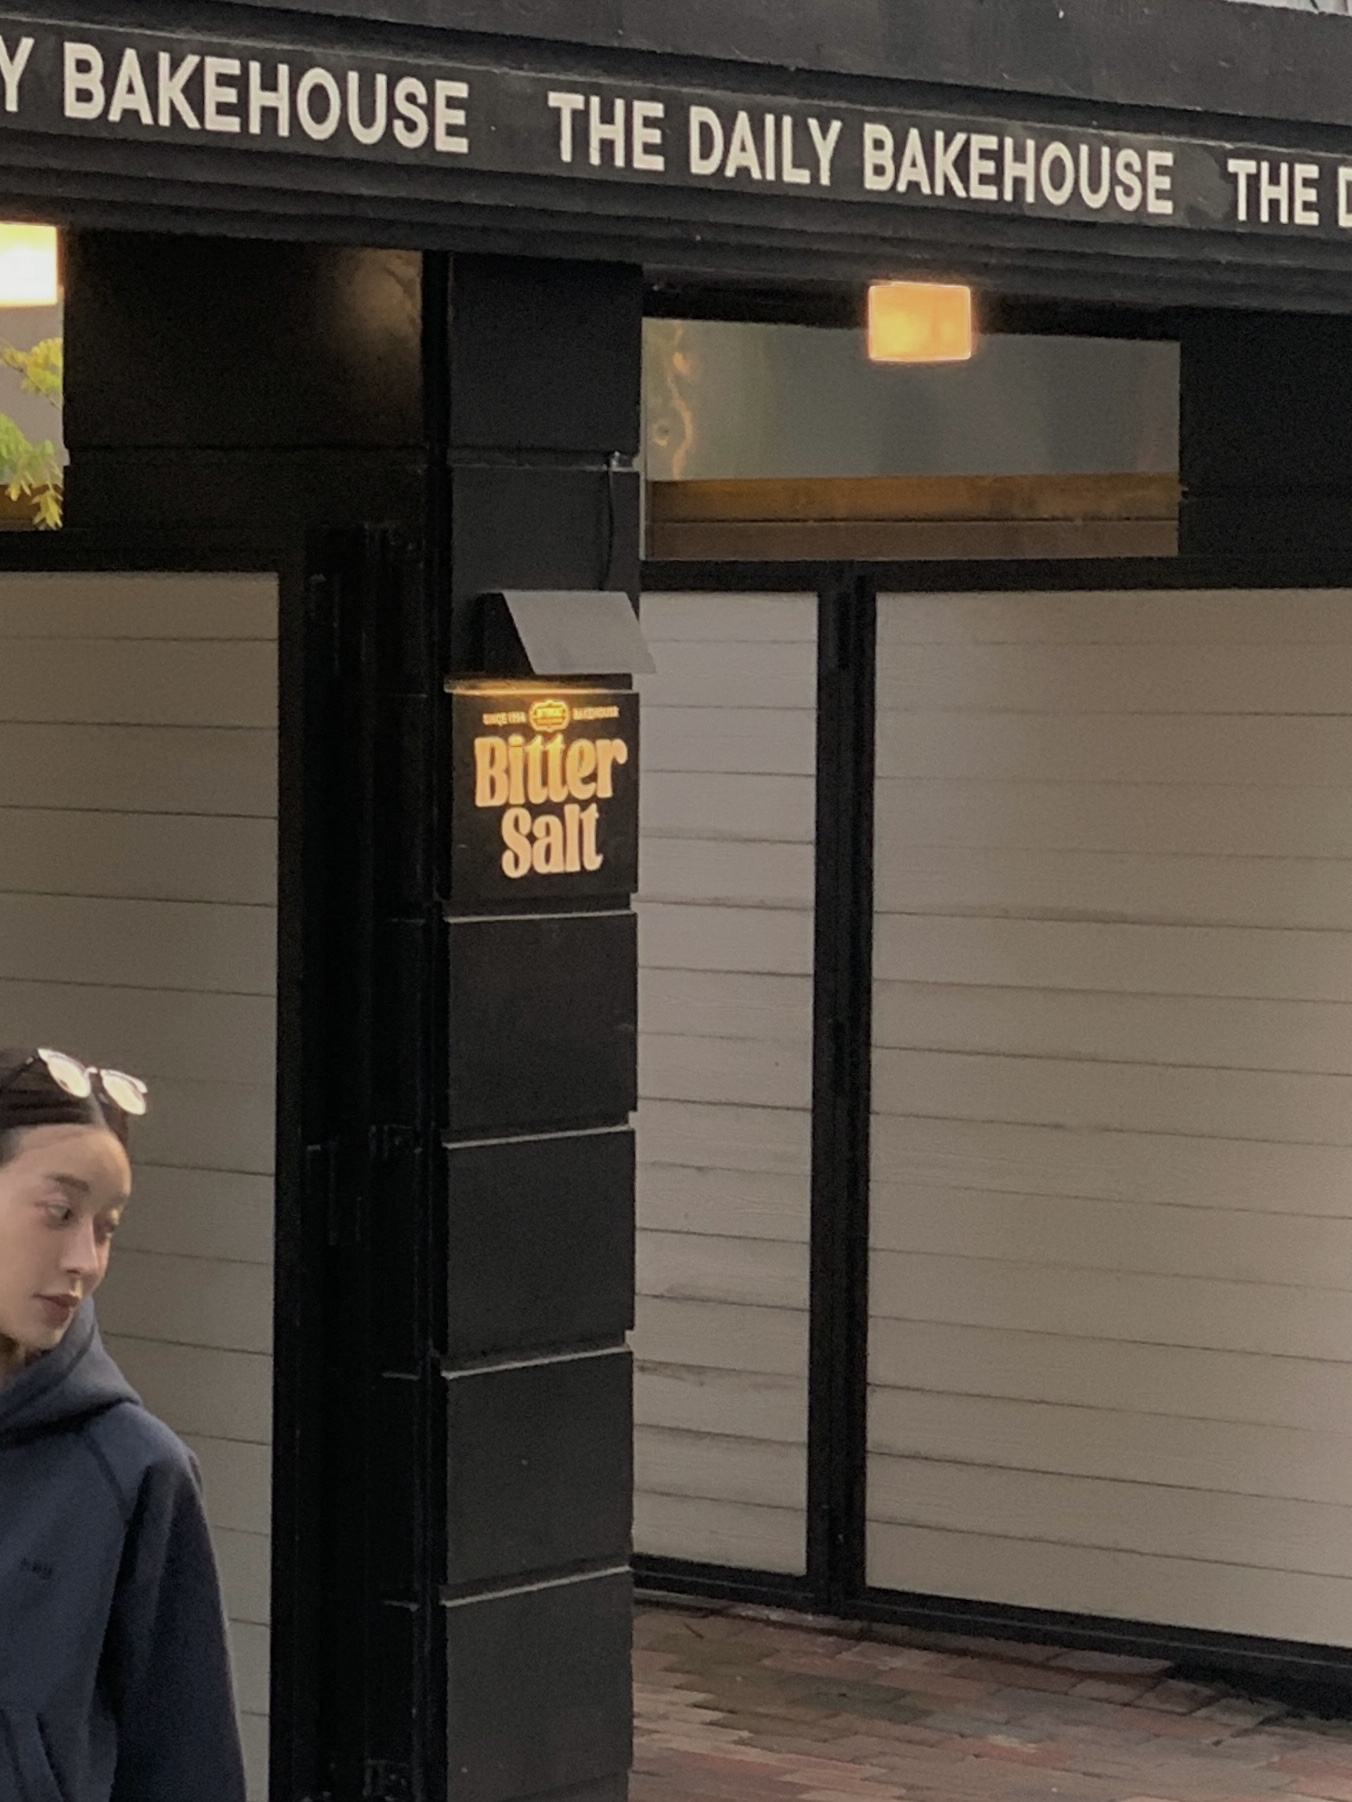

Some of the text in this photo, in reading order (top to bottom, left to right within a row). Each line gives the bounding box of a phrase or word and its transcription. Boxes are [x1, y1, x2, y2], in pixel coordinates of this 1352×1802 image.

[64, 42, 468, 153] BAKEHOUSE
[548, 92, 1173, 214] THE DAILY BAKEHOUSE
[1228, 159, 1319, 225] THE
[474, 733, 627, 807] Bitter
[502, 803, 603, 878] Salt
